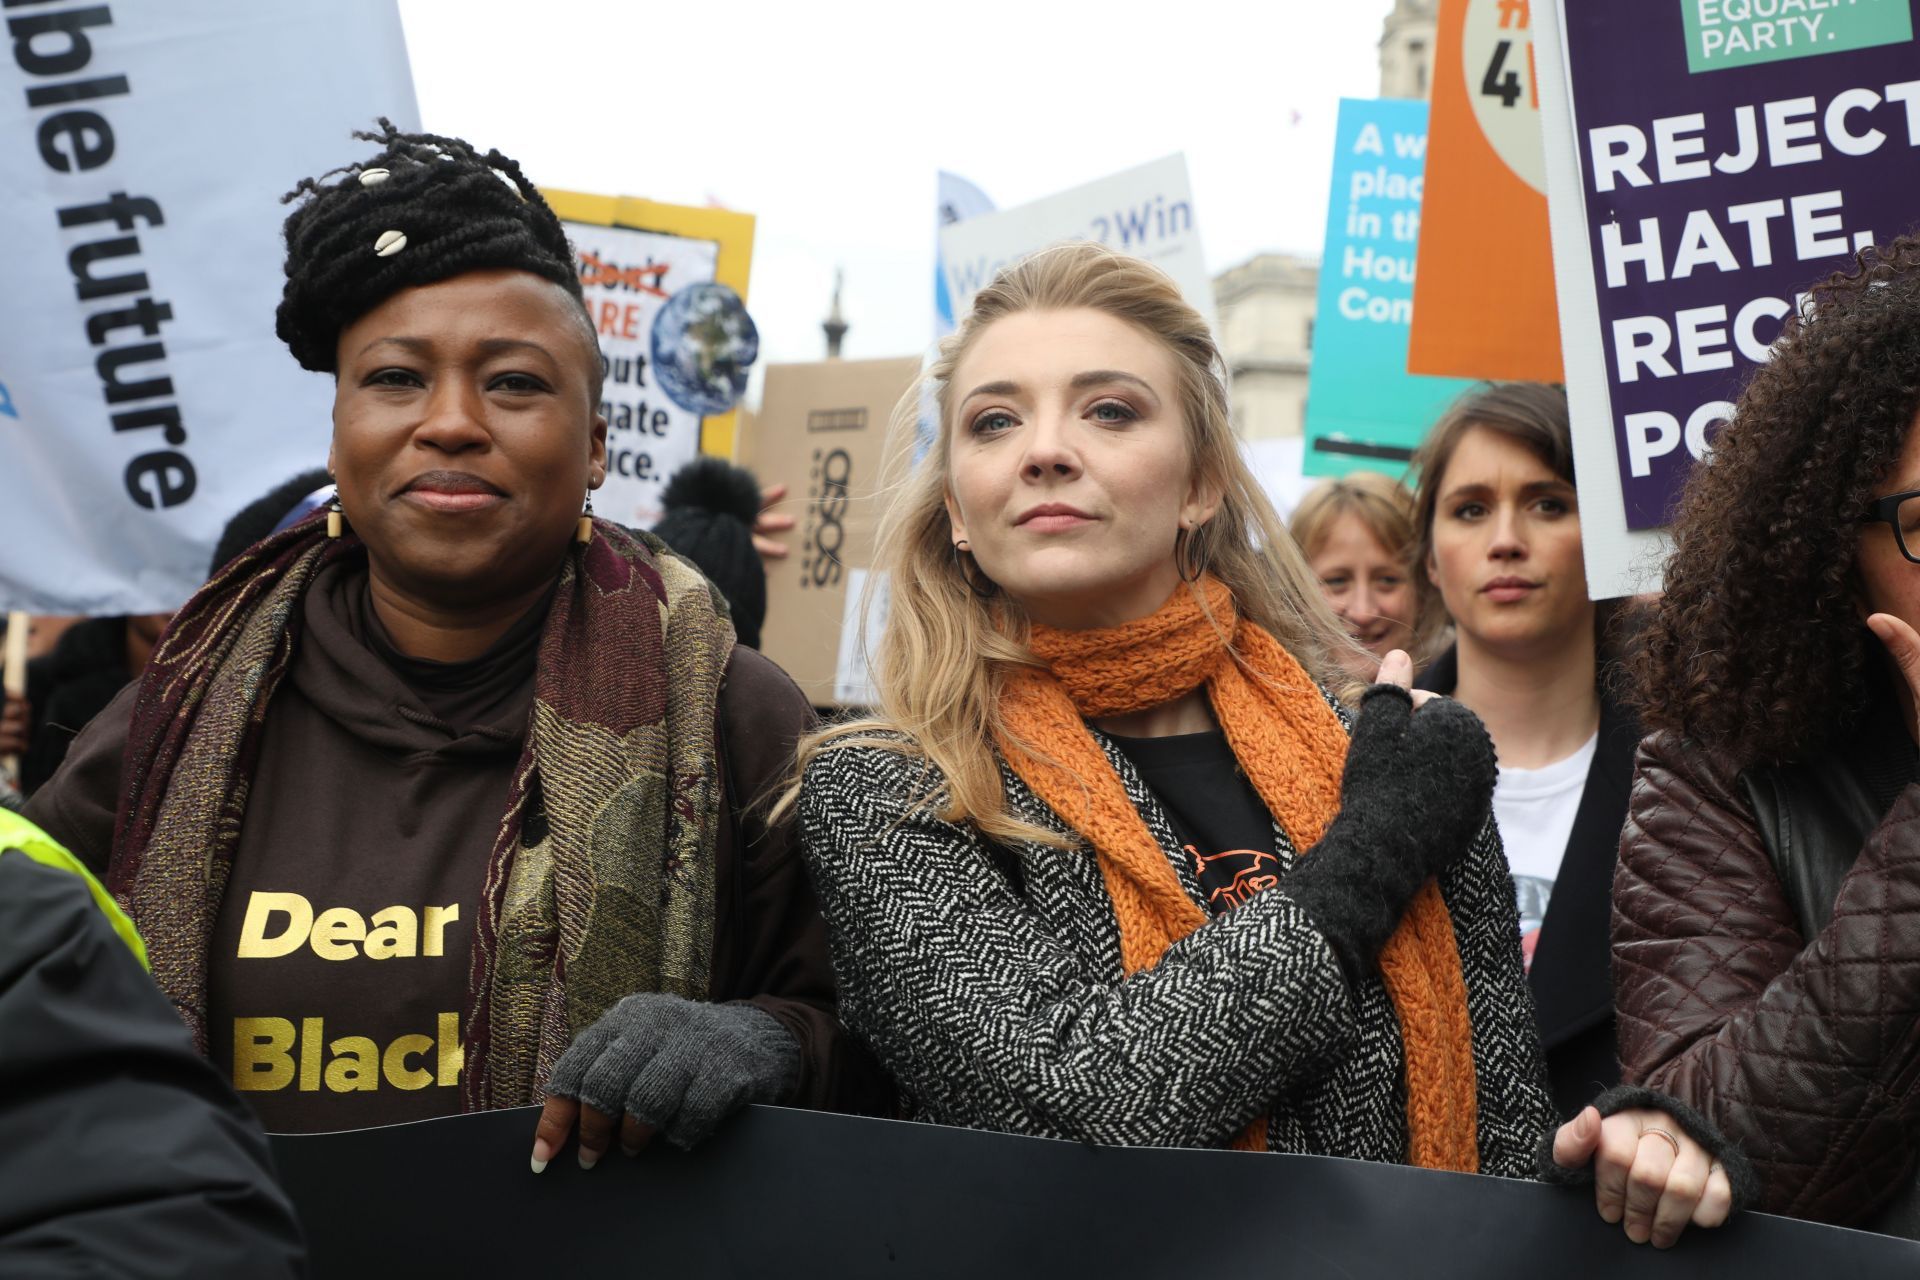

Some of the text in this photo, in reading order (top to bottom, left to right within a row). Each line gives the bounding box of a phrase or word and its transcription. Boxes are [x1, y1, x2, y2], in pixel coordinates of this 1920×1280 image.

[1701, 13, 1835, 59] PARTY.
[1353, 123, 1384, 156] A
[1589, 80, 1920, 192] REJECT
[2, 0, 198, 511] ble future
[1345, 202, 1382, 237] in
[1600, 190, 1874, 289] HATE.
[237, 890, 460, 961] Dear
[233, 1012, 465, 1093] Black
